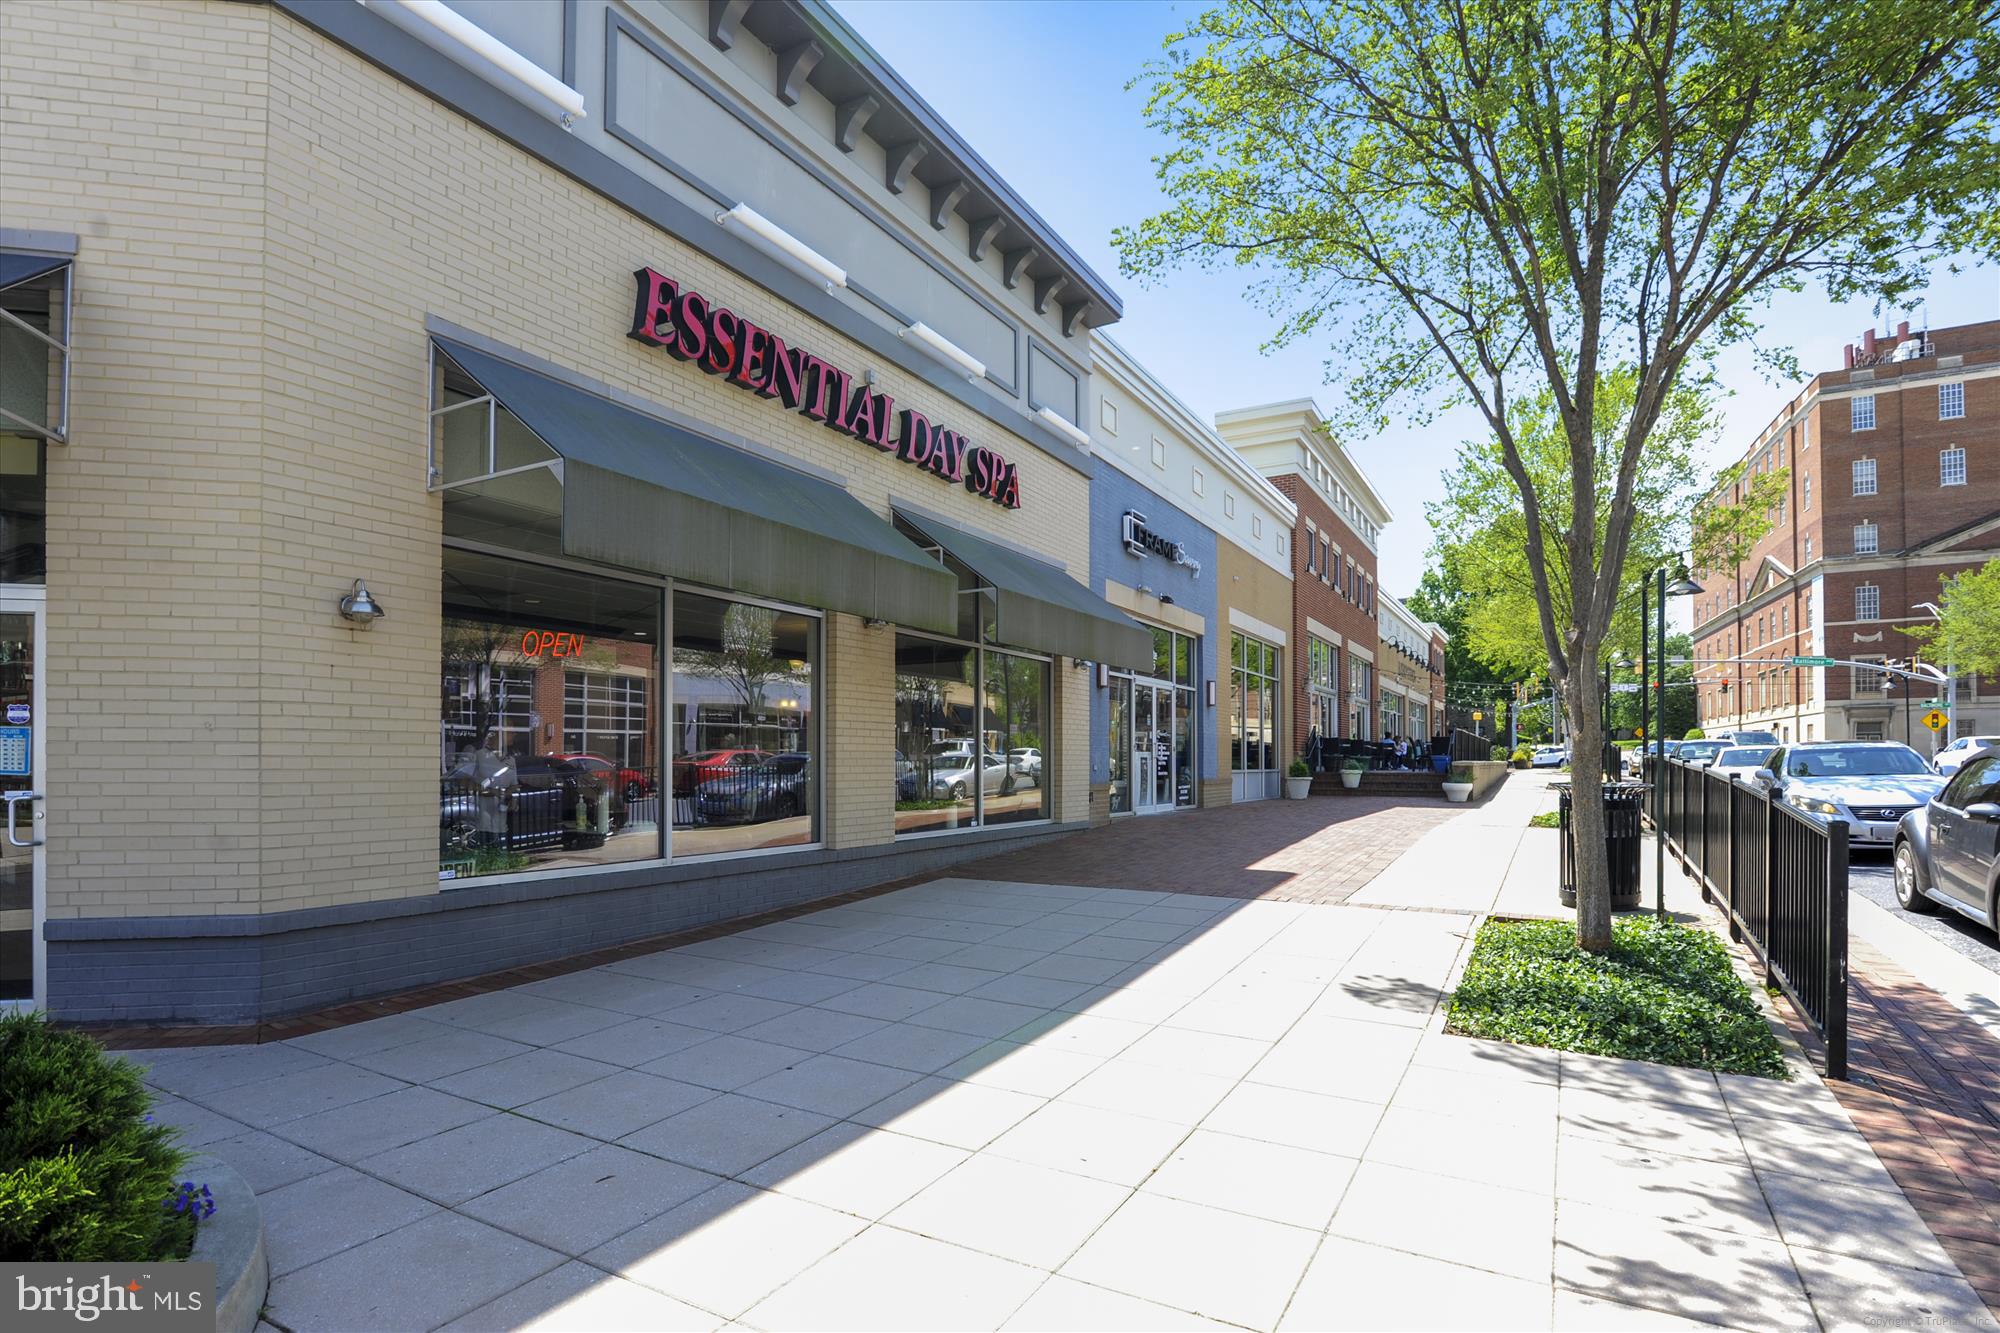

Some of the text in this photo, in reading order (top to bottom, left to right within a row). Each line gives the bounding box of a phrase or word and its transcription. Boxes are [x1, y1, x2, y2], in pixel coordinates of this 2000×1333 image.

[627, 266, 1021, 509] ESSENTIAL DAY SPA
[522, 630, 585, 657] OPEN
